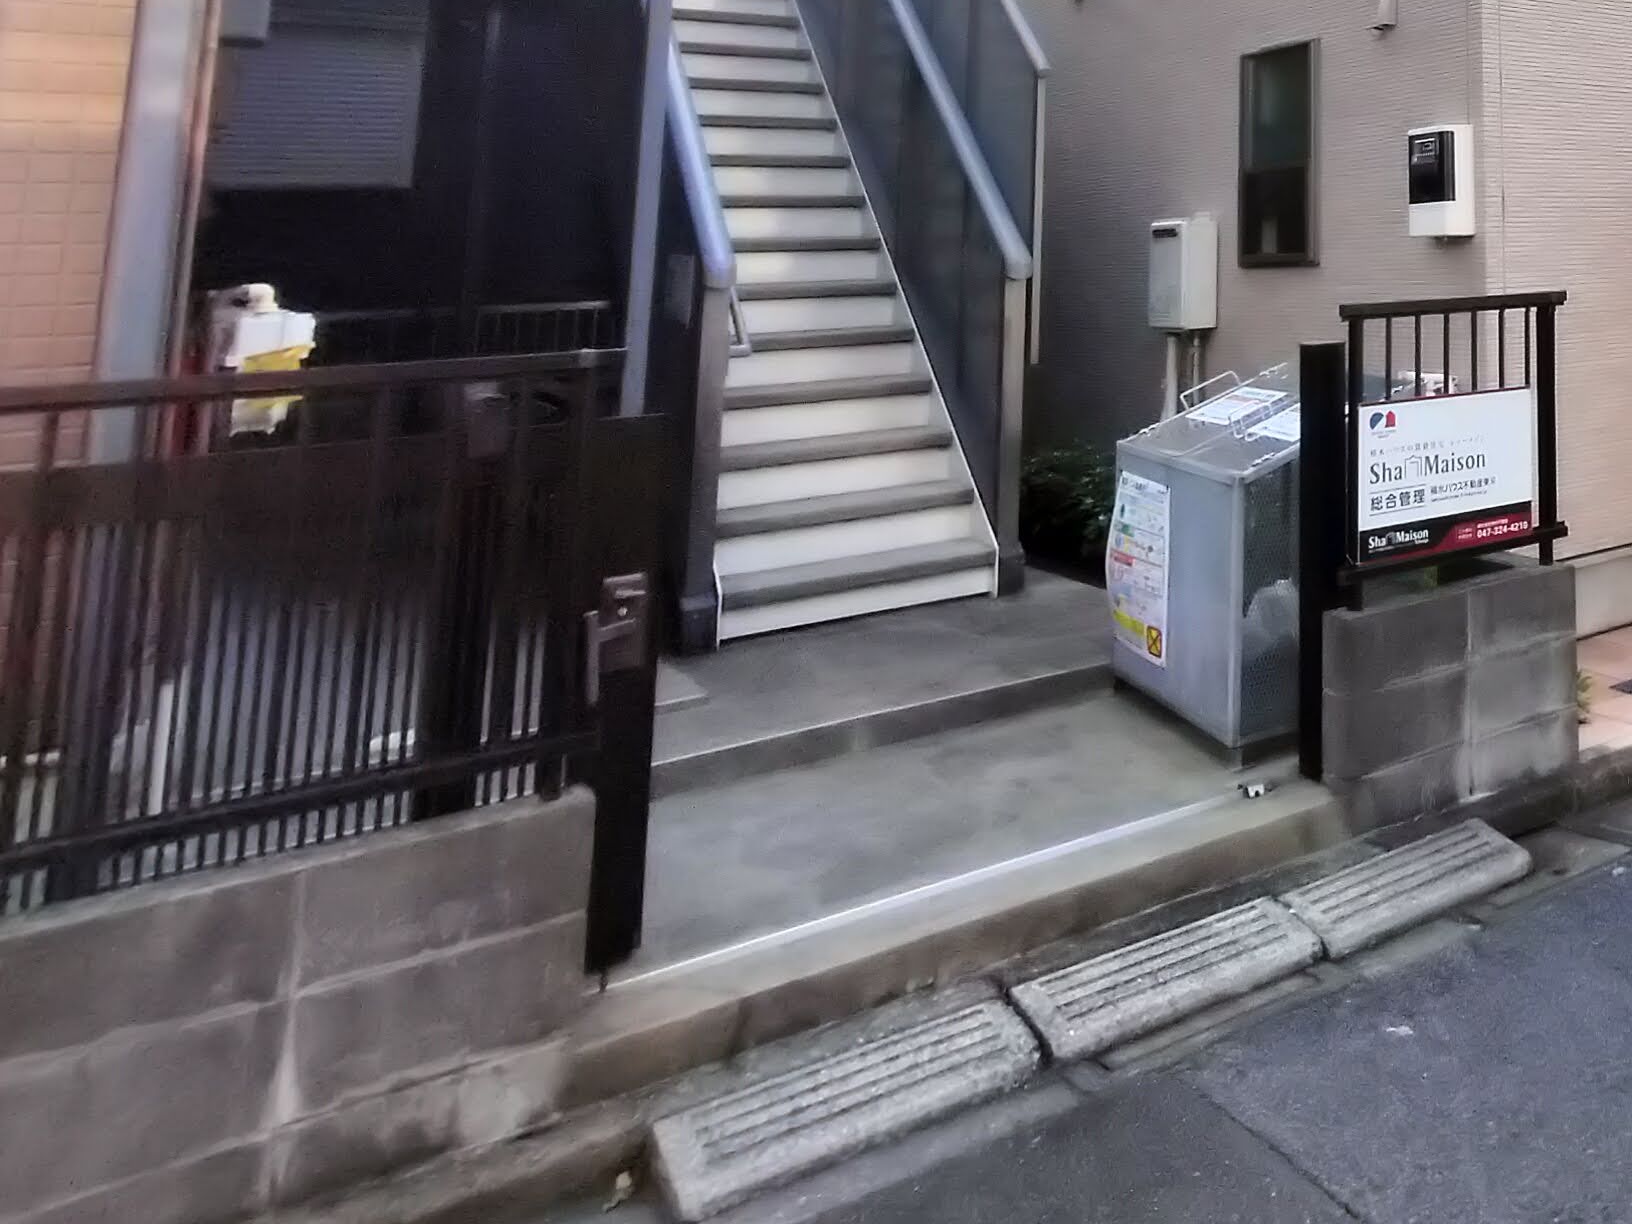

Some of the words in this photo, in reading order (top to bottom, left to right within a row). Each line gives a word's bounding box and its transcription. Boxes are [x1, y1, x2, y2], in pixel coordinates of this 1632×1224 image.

[1369, 461, 1402, 485] Sha
[1424, 452, 1486, 477] Maison
[1370, 489, 1425, 511] 総合管理
[1368, 536, 1386, 549] Sha
[1396, 529, 1429, 543] Maison
